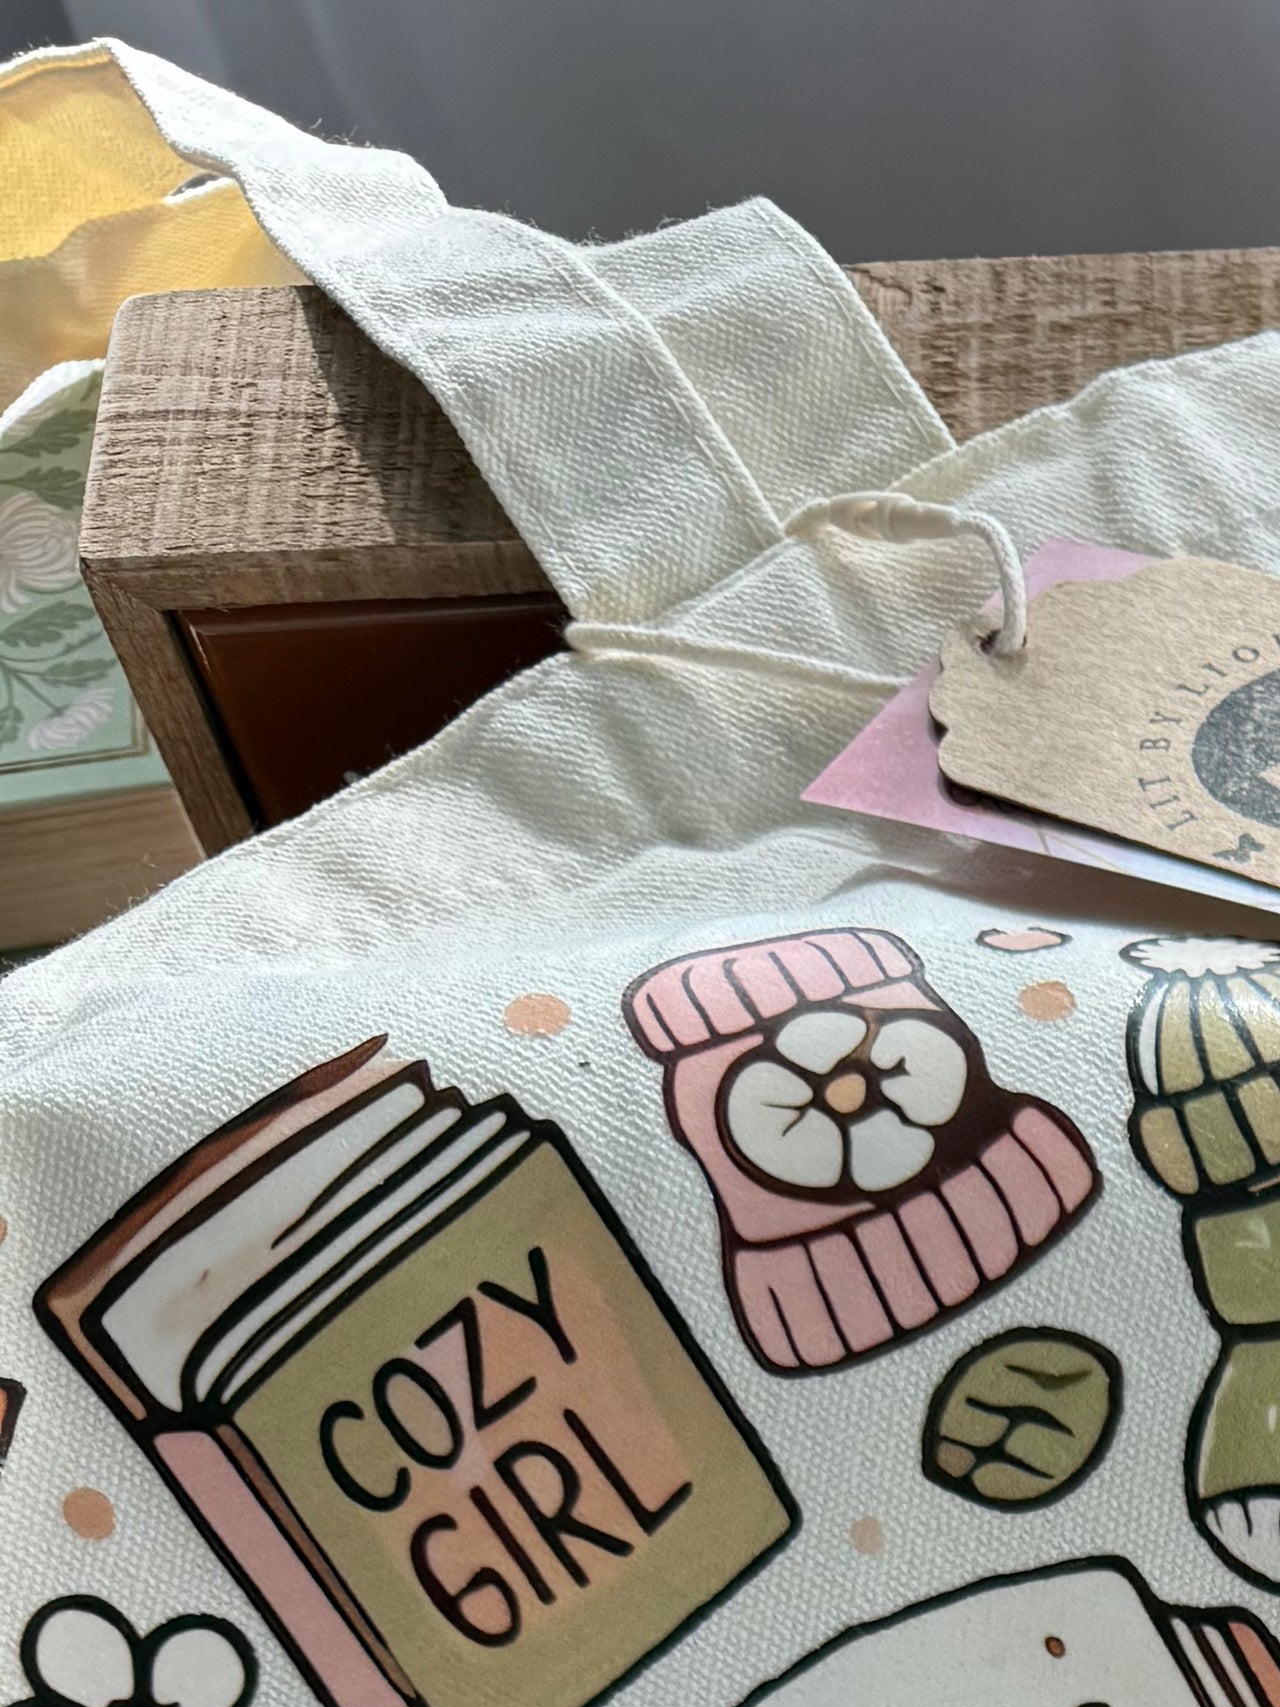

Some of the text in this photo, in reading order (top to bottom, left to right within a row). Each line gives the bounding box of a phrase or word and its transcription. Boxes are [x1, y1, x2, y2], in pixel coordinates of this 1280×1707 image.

[1137, 775, 1198, 831] LIT
[1139, 711, 1182, 751] BY
[319, 1246, 578, 1512] COZY
[410, 1408, 694, 1647] GIRL
